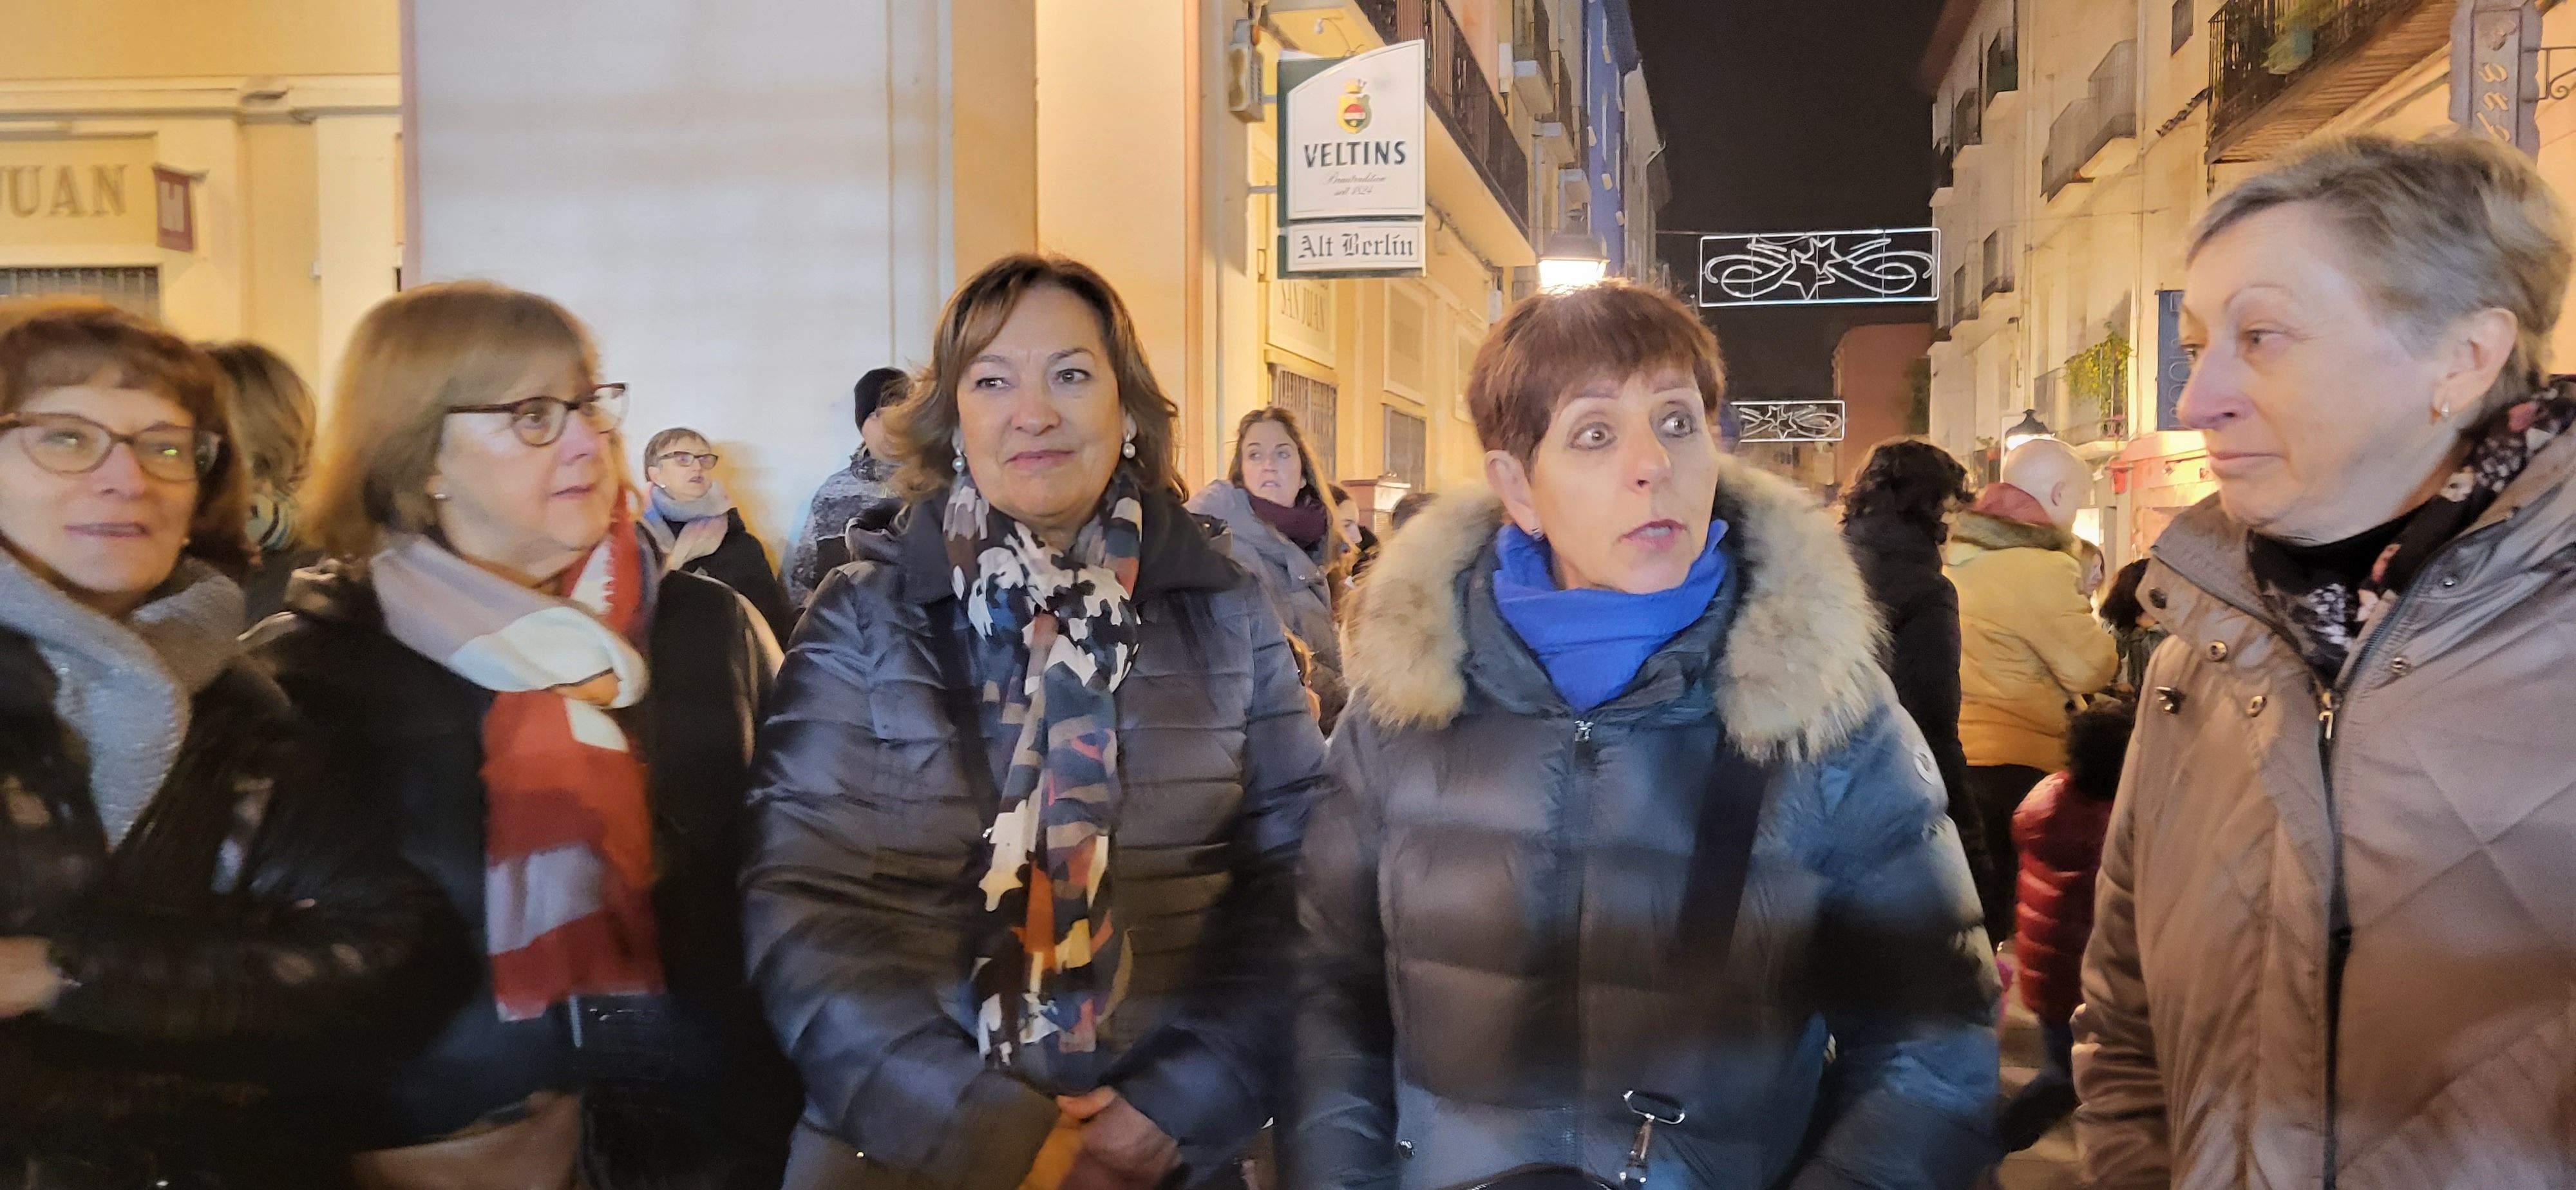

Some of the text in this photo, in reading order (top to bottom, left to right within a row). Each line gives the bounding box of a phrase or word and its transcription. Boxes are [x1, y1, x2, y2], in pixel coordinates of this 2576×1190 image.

[1304, 141, 1406, 168] VELTINS
[0, 165, 128, 217] UAN
[1298, 235, 1333, 258] Alt
